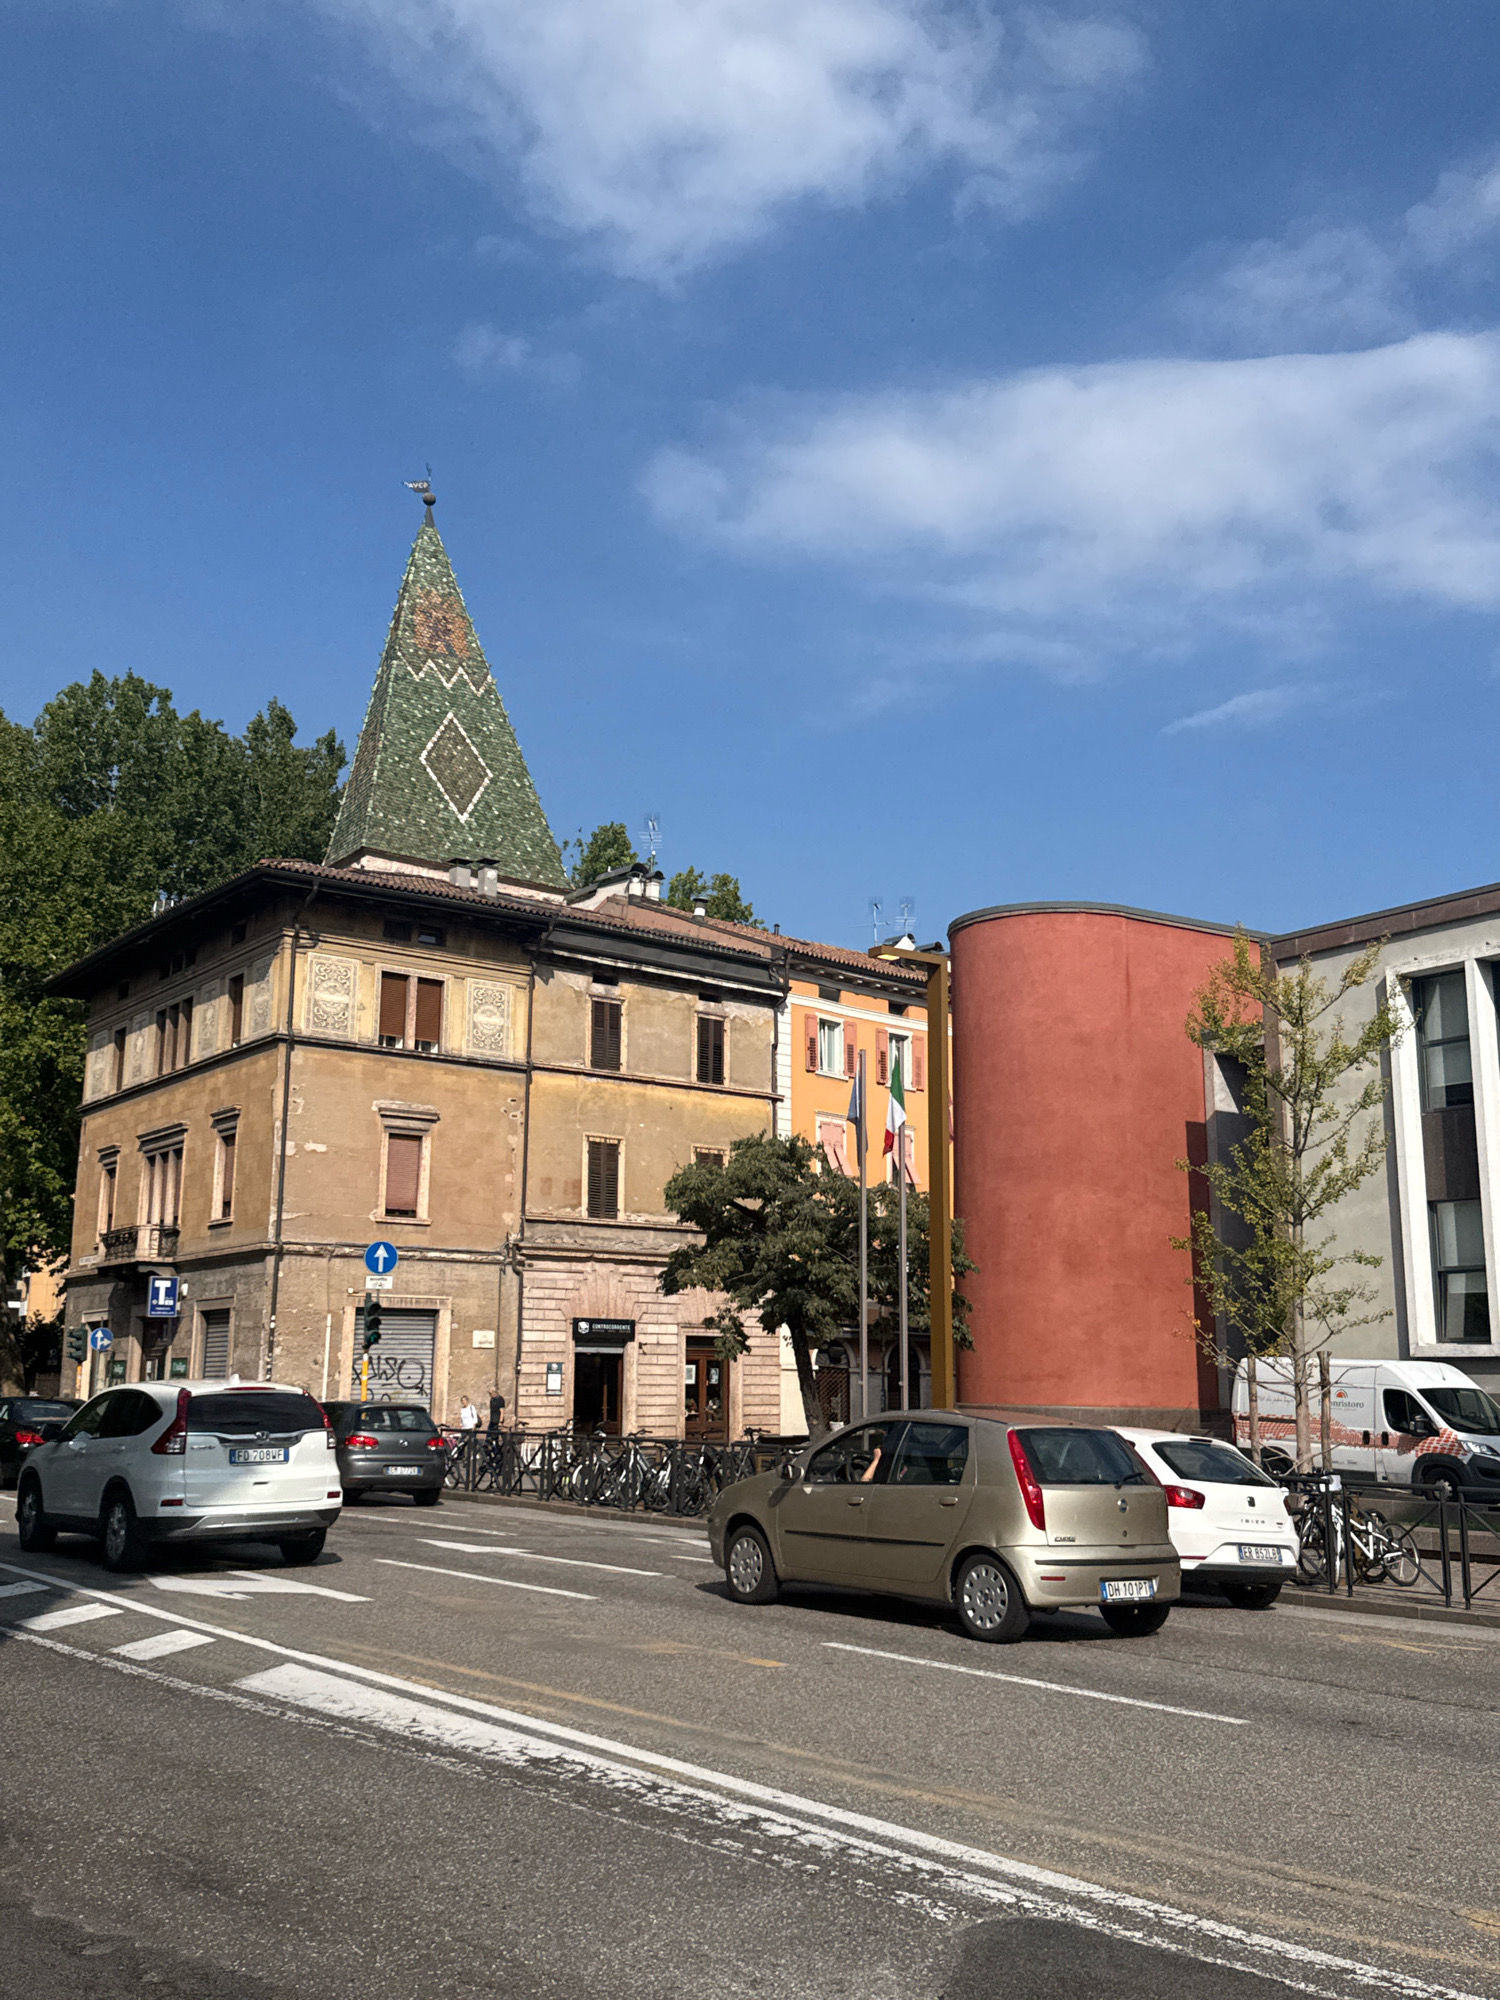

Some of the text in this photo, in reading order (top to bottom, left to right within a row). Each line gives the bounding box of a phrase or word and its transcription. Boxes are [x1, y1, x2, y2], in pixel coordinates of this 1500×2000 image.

[155, 1280, 171, 1305] T
[237, 1450, 283, 1461] FD 708WF
[1243, 1546, 1277, 1560] ER 852LB
[1108, 1582, 1148, 1597] DH 101PT
